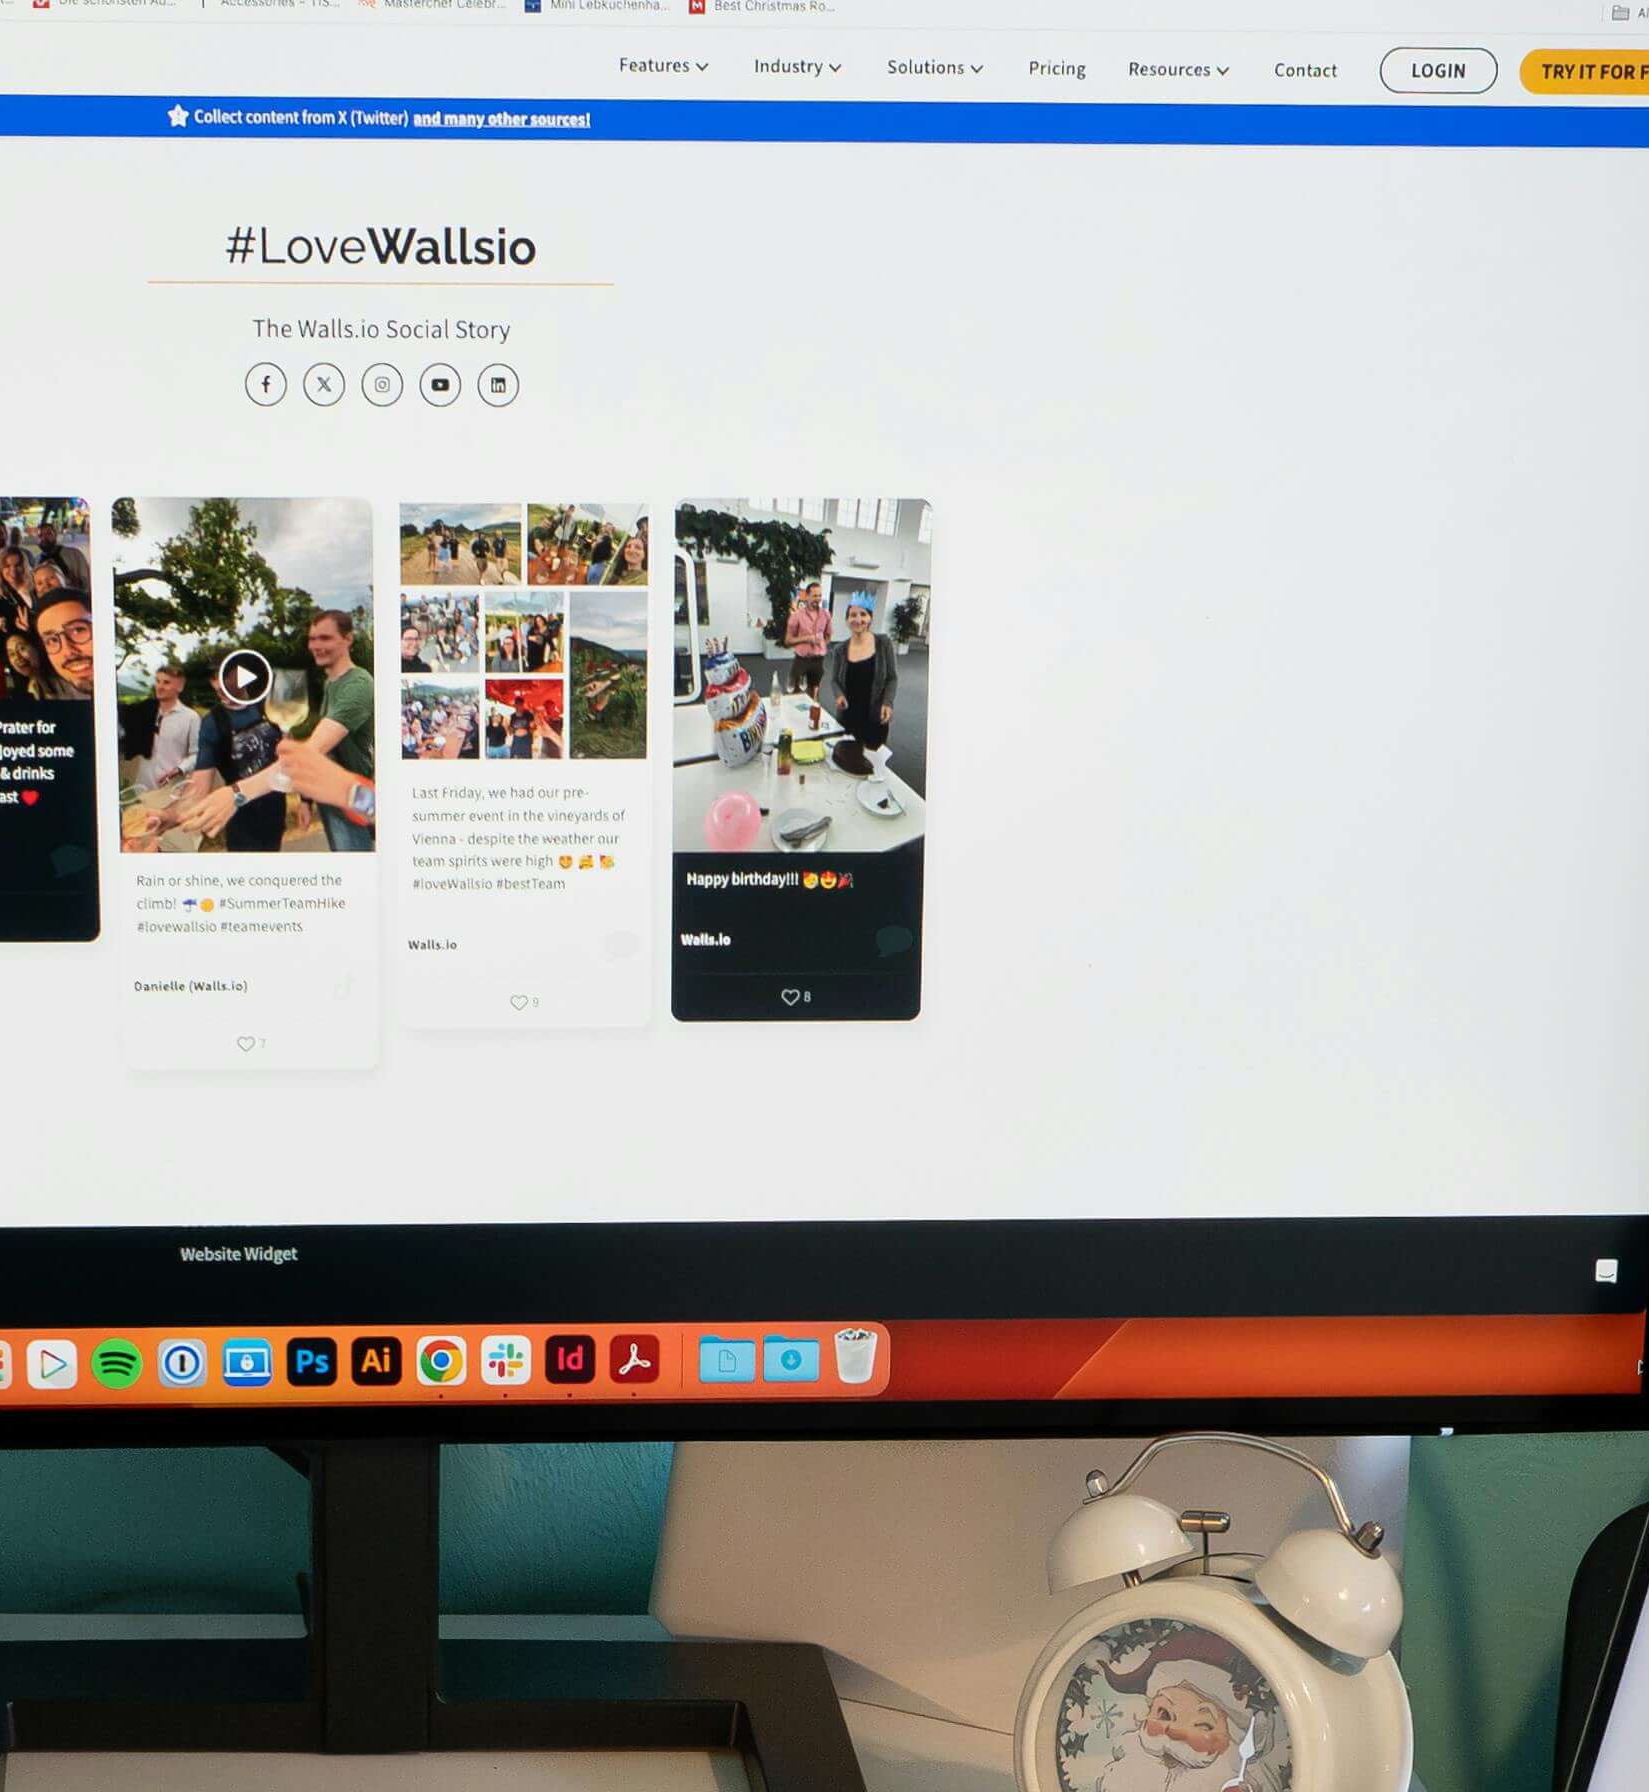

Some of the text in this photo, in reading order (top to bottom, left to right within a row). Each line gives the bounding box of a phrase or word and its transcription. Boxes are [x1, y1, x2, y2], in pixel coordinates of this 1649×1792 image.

[620, 57, 690, 73] Features
[755, 58, 824, 78] Industry
[888, 59, 964, 75] Solutions
[1029, 60, 1087, 81] Pricing
[1129, 61, 1211, 77] Resources
[1274, 62, 1337, 78] Contact
[1412, 63, 1466, 79] LOGIN
[1542, 63, 1576, 80] TRY
[1579, 64, 1597, 80] IT
[1600, 64, 1636, 80] FOR
[194, 108, 592, 131] Collect content from X (Twitter) and many other sources!
[226, 226, 536, 265] #LoveWallsio
[252, 318, 511, 345] The Walls.io Social Story
[36, 719, 57, 735] for
[37, 746, 75, 758] some
[0, 766, 11, 780] &
[12, 766, 55, 781] drinks
[412, 786, 589, 802] Last Friday, we had our pre-
[136, 873, 343, 890] Rain or shine, we conquered the
[413, 877, 566, 890] #loveWallsio #bestTeam
[685, 871, 799, 889] Happy birthday!!!
[137, 920, 303, 933] #lovewallsio #teamevents
[408, 939, 457, 951] Walls.io
[679, 932, 732, 947] Walls.io
[134, 980, 248, 994] Danielle (Walls.io)
[180, 1245, 298, 1265] Website Widget
[296, 1349, 329, 1374] Ps
[361, 1347, 391, 1373] Ai
[557, 1344, 583, 1371] Id
